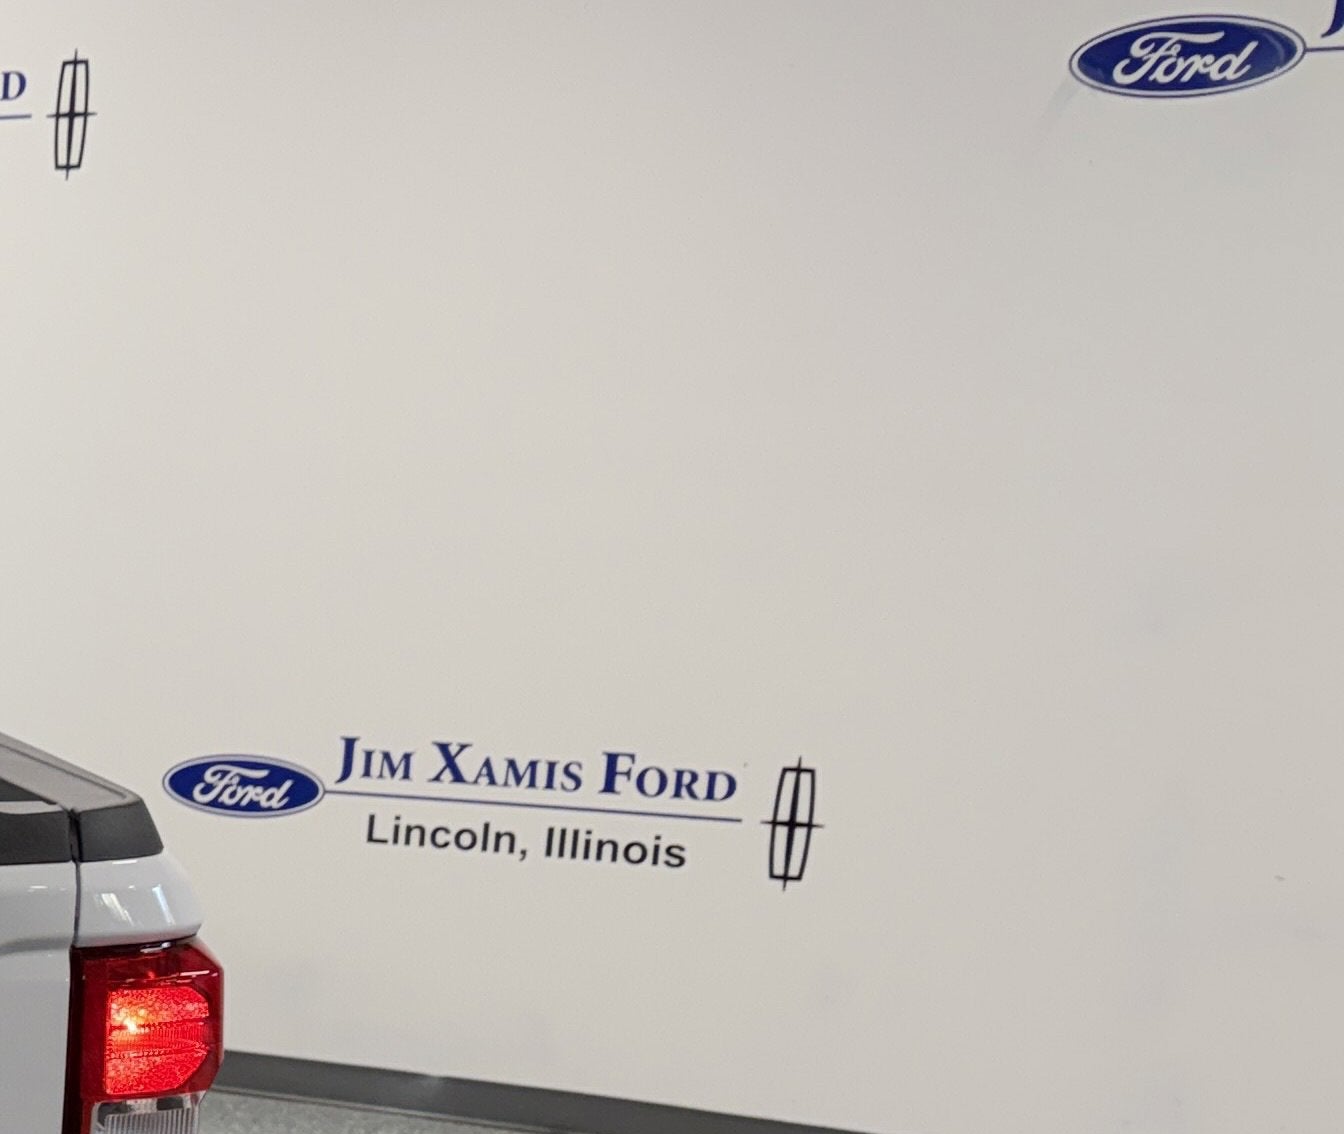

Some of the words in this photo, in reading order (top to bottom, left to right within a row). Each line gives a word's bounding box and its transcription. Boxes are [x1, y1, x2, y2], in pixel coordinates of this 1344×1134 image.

[1113, 31, 1258, 85] Ford
[192, 765, 291, 810] Ford
[334, 736, 416, 784] JIM
[431, 741, 583, 794] XAMIS
[597, 751, 739, 801] FORD
[366, 813, 529, 862] Lincoln,
[544, 826, 687, 869] Illinois
